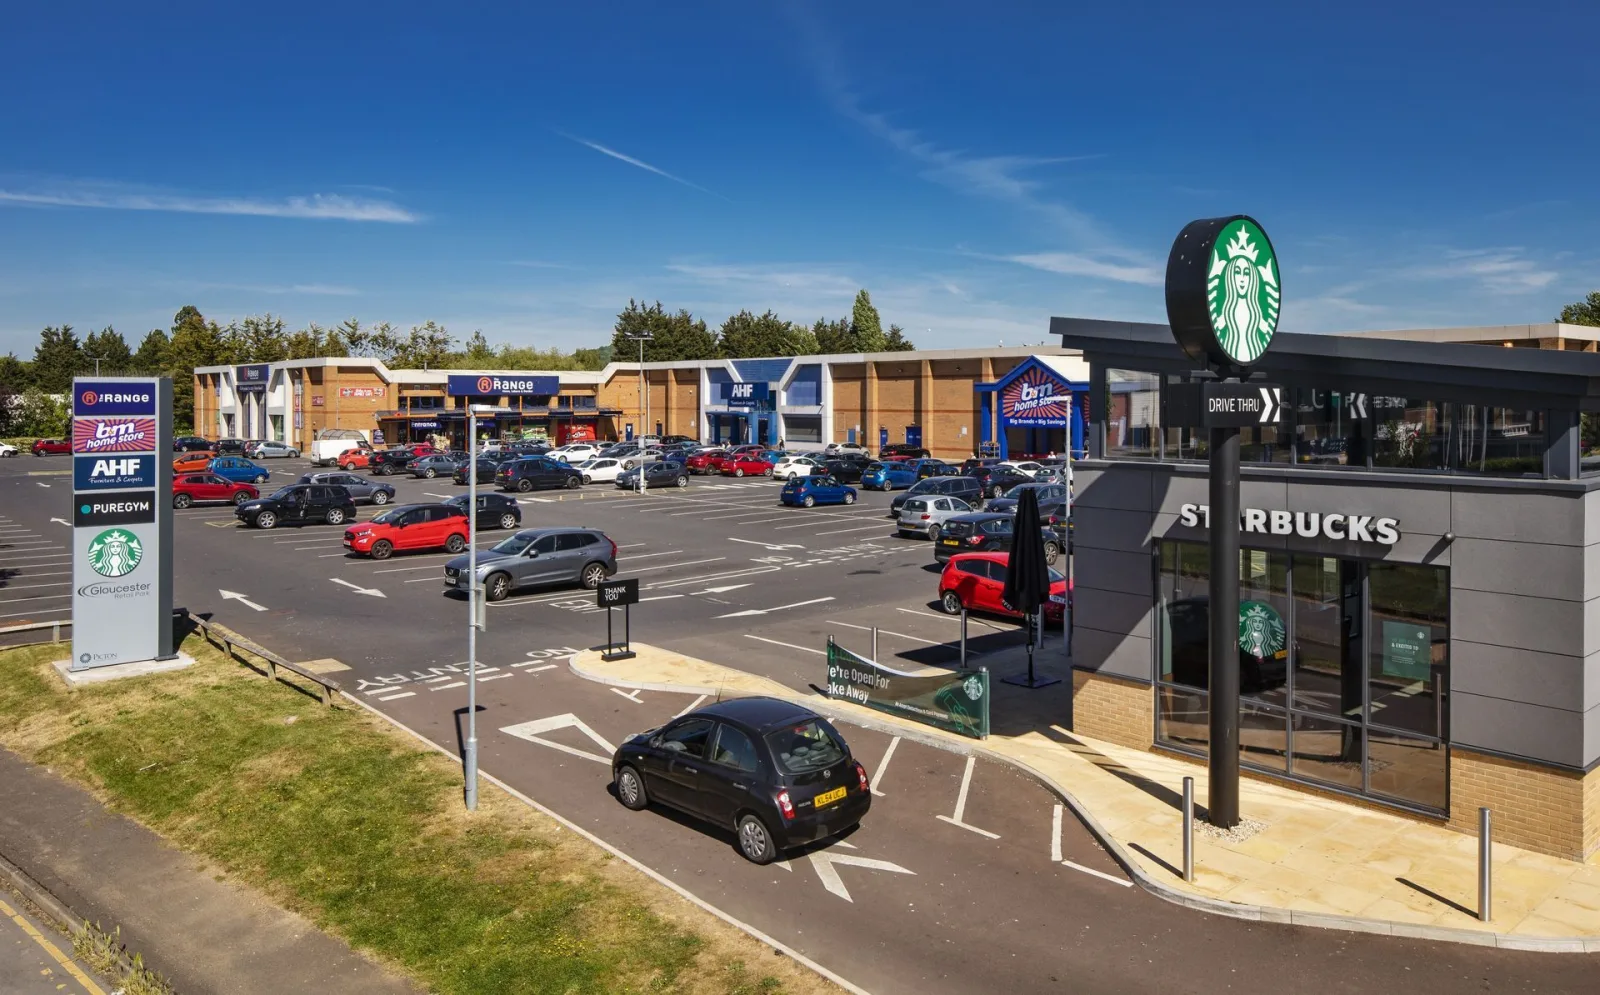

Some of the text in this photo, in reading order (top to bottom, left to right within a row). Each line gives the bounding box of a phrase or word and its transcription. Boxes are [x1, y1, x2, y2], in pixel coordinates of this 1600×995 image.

[731, 384, 753, 398] AHF
[1014, 400, 1038, 411] home
[1208, 398, 1260, 413] DRIVE THRU
[1038, 418, 1046, 426] Big
[86, 431, 145, 449] home store
[91, 458, 141, 477] AHF
[93, 501, 150, 514] PUREGYM
[1180, 503, 1399, 545] STRBUCKS
[90, 582, 151, 596] Gloucester
[604, 586, 626, 595] THANK
[605, 593, 619, 601] YOU
[356, 646, 582, 692] NO ENTRY
[827, 665, 891, 689] e're Open For
[827, 682, 870, 704] ake Away
